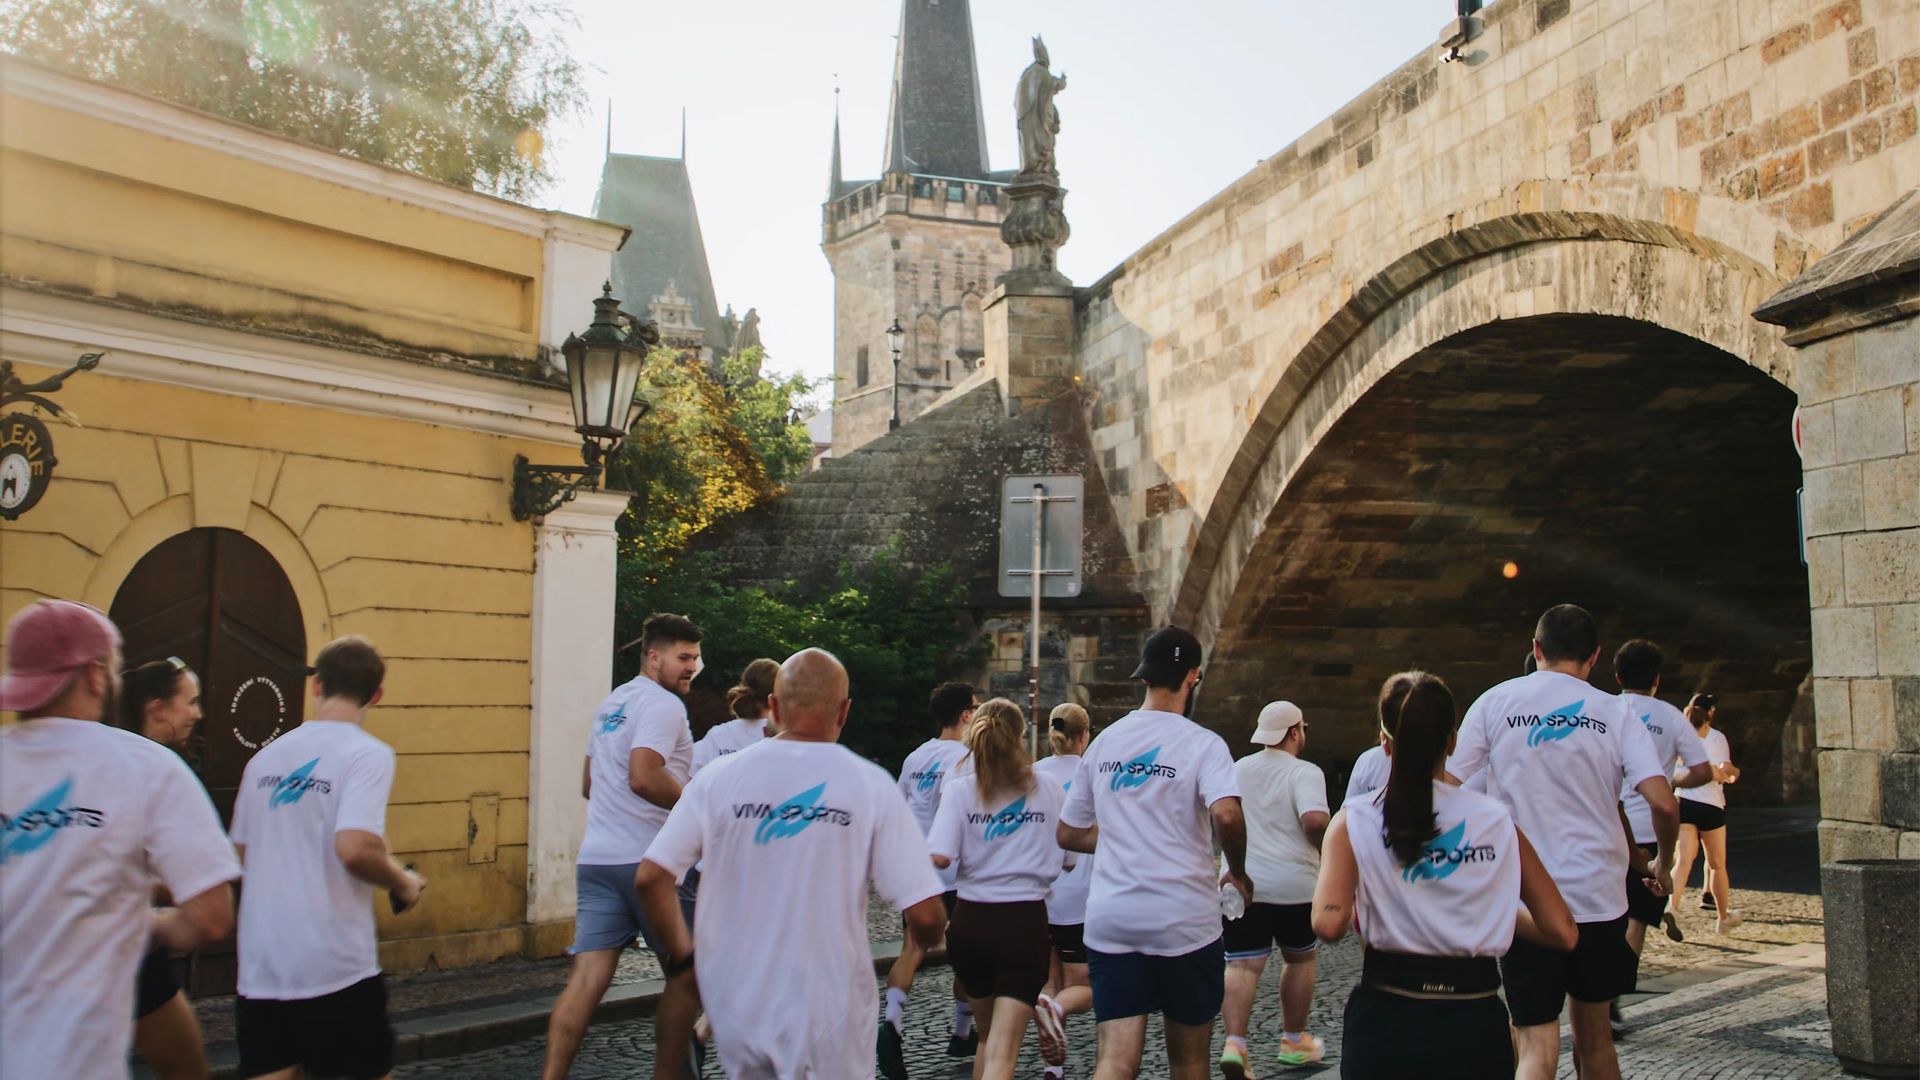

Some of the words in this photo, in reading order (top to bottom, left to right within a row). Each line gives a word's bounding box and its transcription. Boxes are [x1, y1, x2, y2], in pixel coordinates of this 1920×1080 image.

[1506, 715, 1541, 728] VIVA
[1546, 715, 1607, 734] SPORTS
[1099, 762, 1123, 774] VIVA
[1127, 762, 1177, 779] SPORTS
[733, 803, 776, 820] VIVA
[781, 804, 851, 827] SPORTS
[967, 813, 996, 825] VIVA
[999, 811, 1046, 824] SPORTS
[1425, 845, 1497, 865] SPORTS
